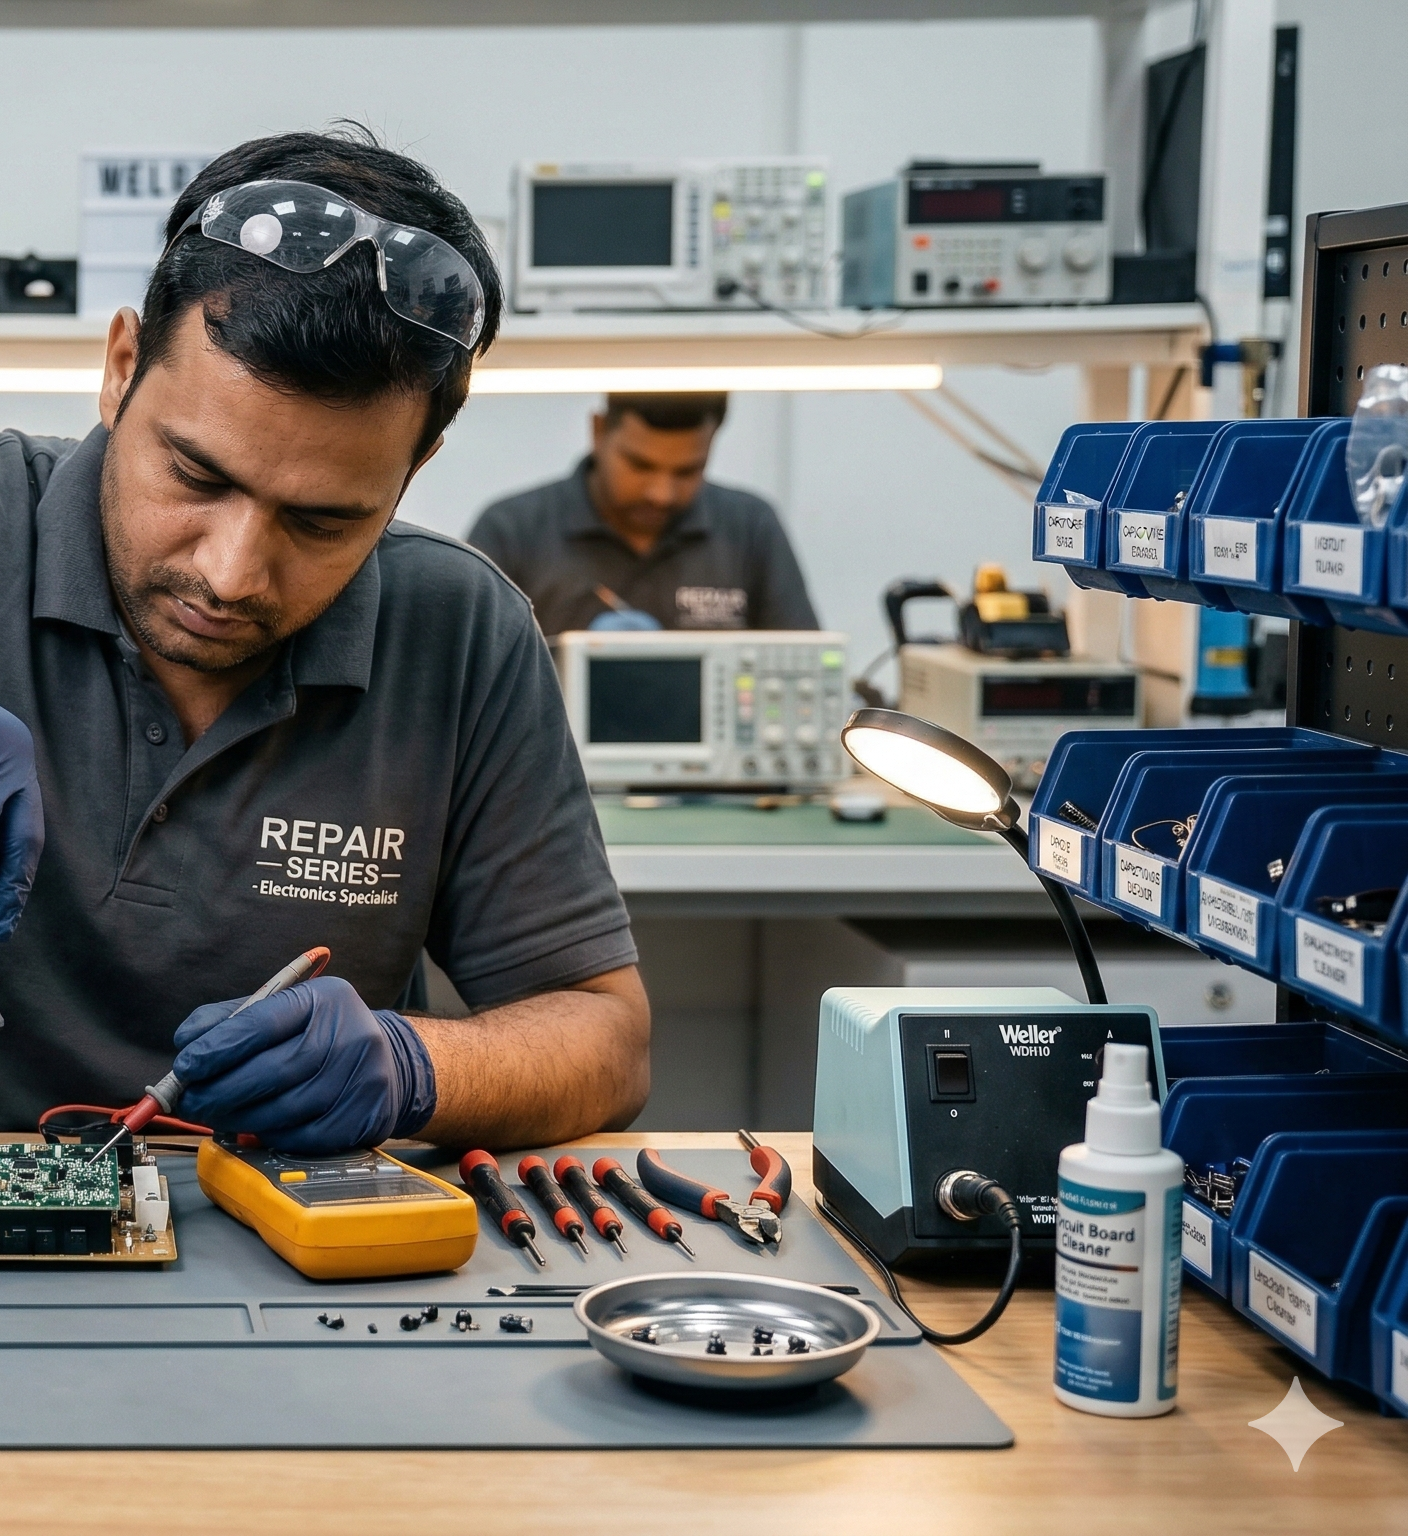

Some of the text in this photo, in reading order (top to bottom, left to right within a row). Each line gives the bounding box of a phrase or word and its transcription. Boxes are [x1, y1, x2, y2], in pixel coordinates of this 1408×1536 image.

[260, 816, 405, 860] REPAIR
[286, 856, 380, 886] SERIES
[339, 888, 399, 907] Specialist
[1088, 1221, 1136, 1243] Board
